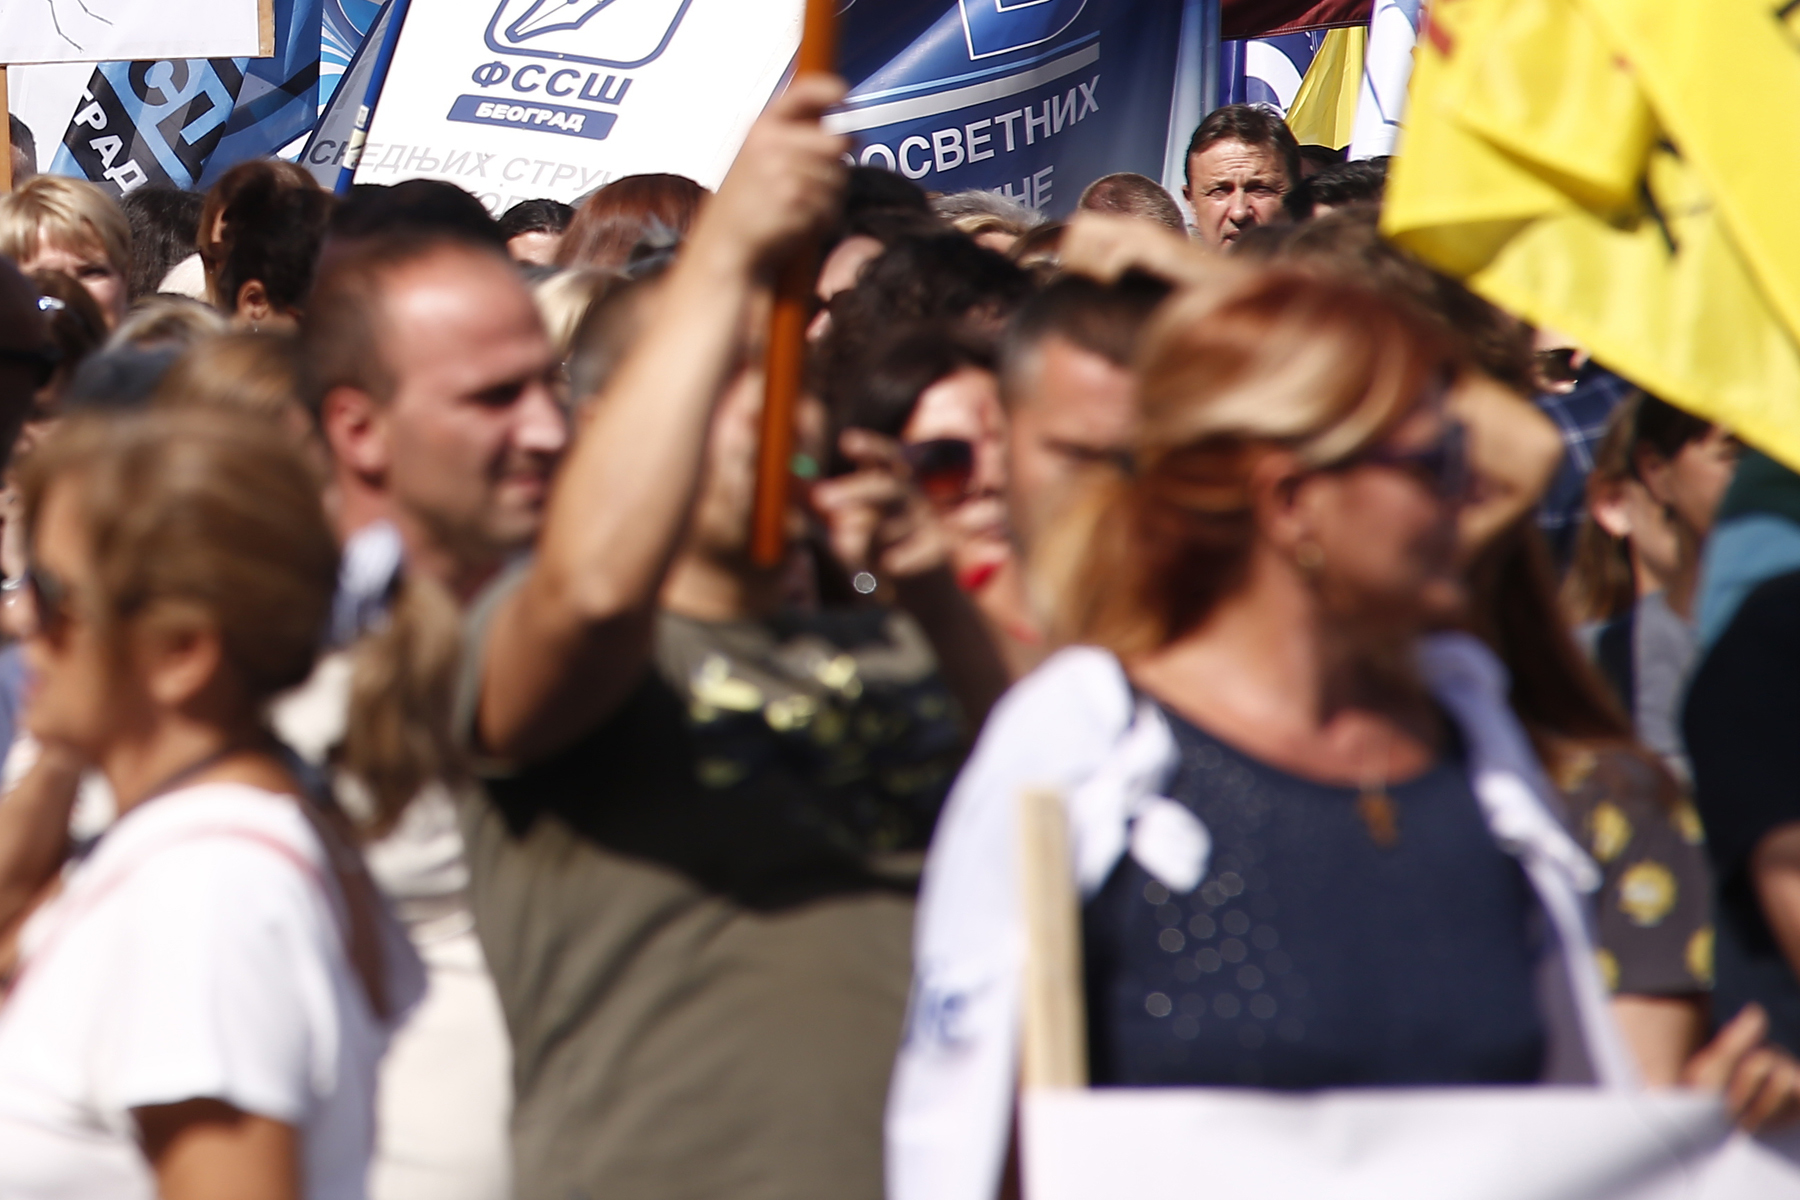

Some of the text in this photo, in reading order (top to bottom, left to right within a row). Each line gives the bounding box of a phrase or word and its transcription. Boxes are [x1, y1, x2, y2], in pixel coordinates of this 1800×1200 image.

[471, 61, 634, 105] ФССШ
[474, 102, 588, 133] БЕОГРАД
[840, 74, 1100, 180] ОСВЕТНИХ
